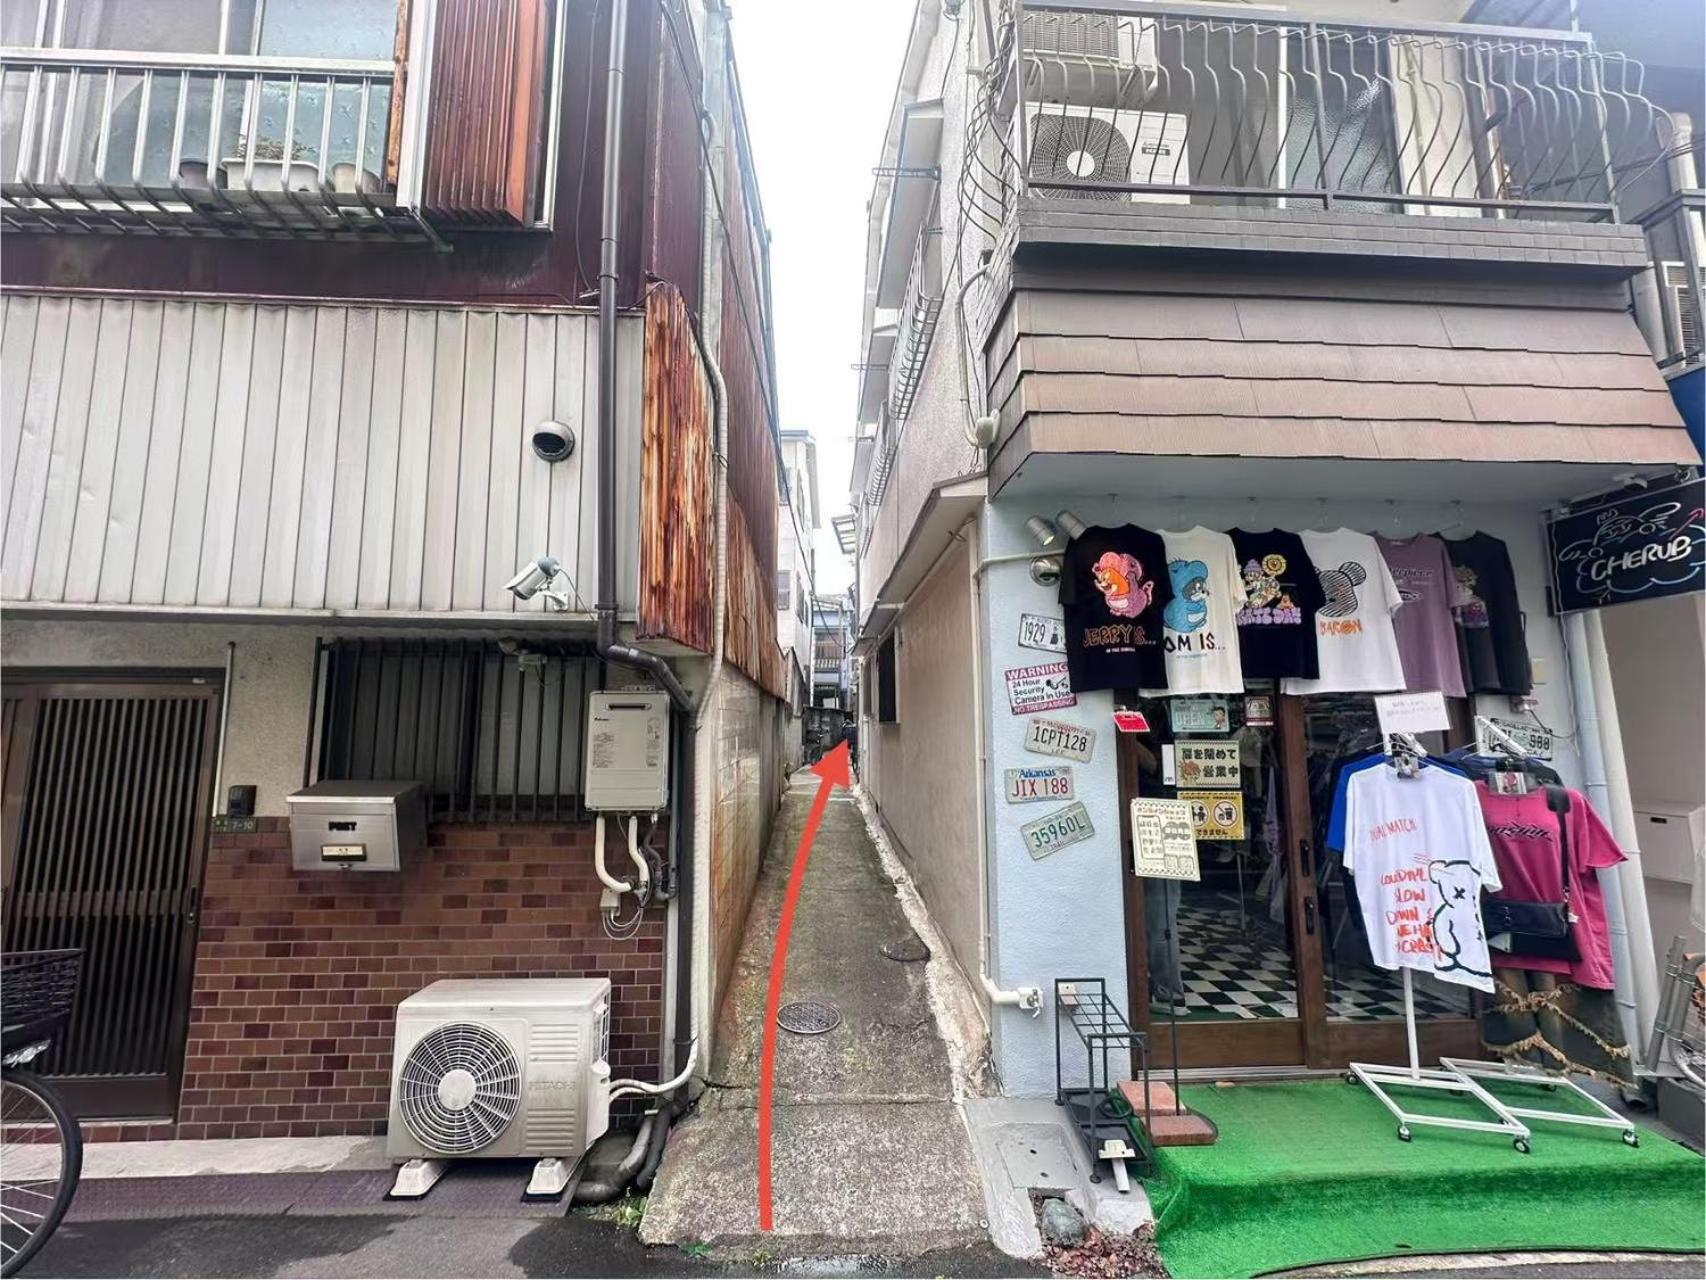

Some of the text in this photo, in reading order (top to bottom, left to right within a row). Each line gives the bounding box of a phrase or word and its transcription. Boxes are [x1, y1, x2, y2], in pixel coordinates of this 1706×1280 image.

[1591, 536, 1693, 581] CHERUB
[1024, 621, 1046, 644] 1929
[1083, 624, 1133, 648] JERRY
[1007, 662, 1067, 680] WARNING
[1013, 679, 1041, 688] 24 Hour
[1013, 686, 1045, 696] Security
[1014, 695, 1045, 704] Camera
[1055, 690, 1071, 699] Use
[1026, 699, 1075, 712] TRESPASSING
[1033, 725, 1087, 752] 1CPT128
[1182, 748, 1236, 760] 扉を閉めて
[1019, 768, 1057, 779] Arkansas
[1203, 765, 1238, 777] 営業中
[1012, 779, 1037, 797] JIX
[328, 821, 357, 832] POST
[1031, 815, 1086, 849] 35960L
